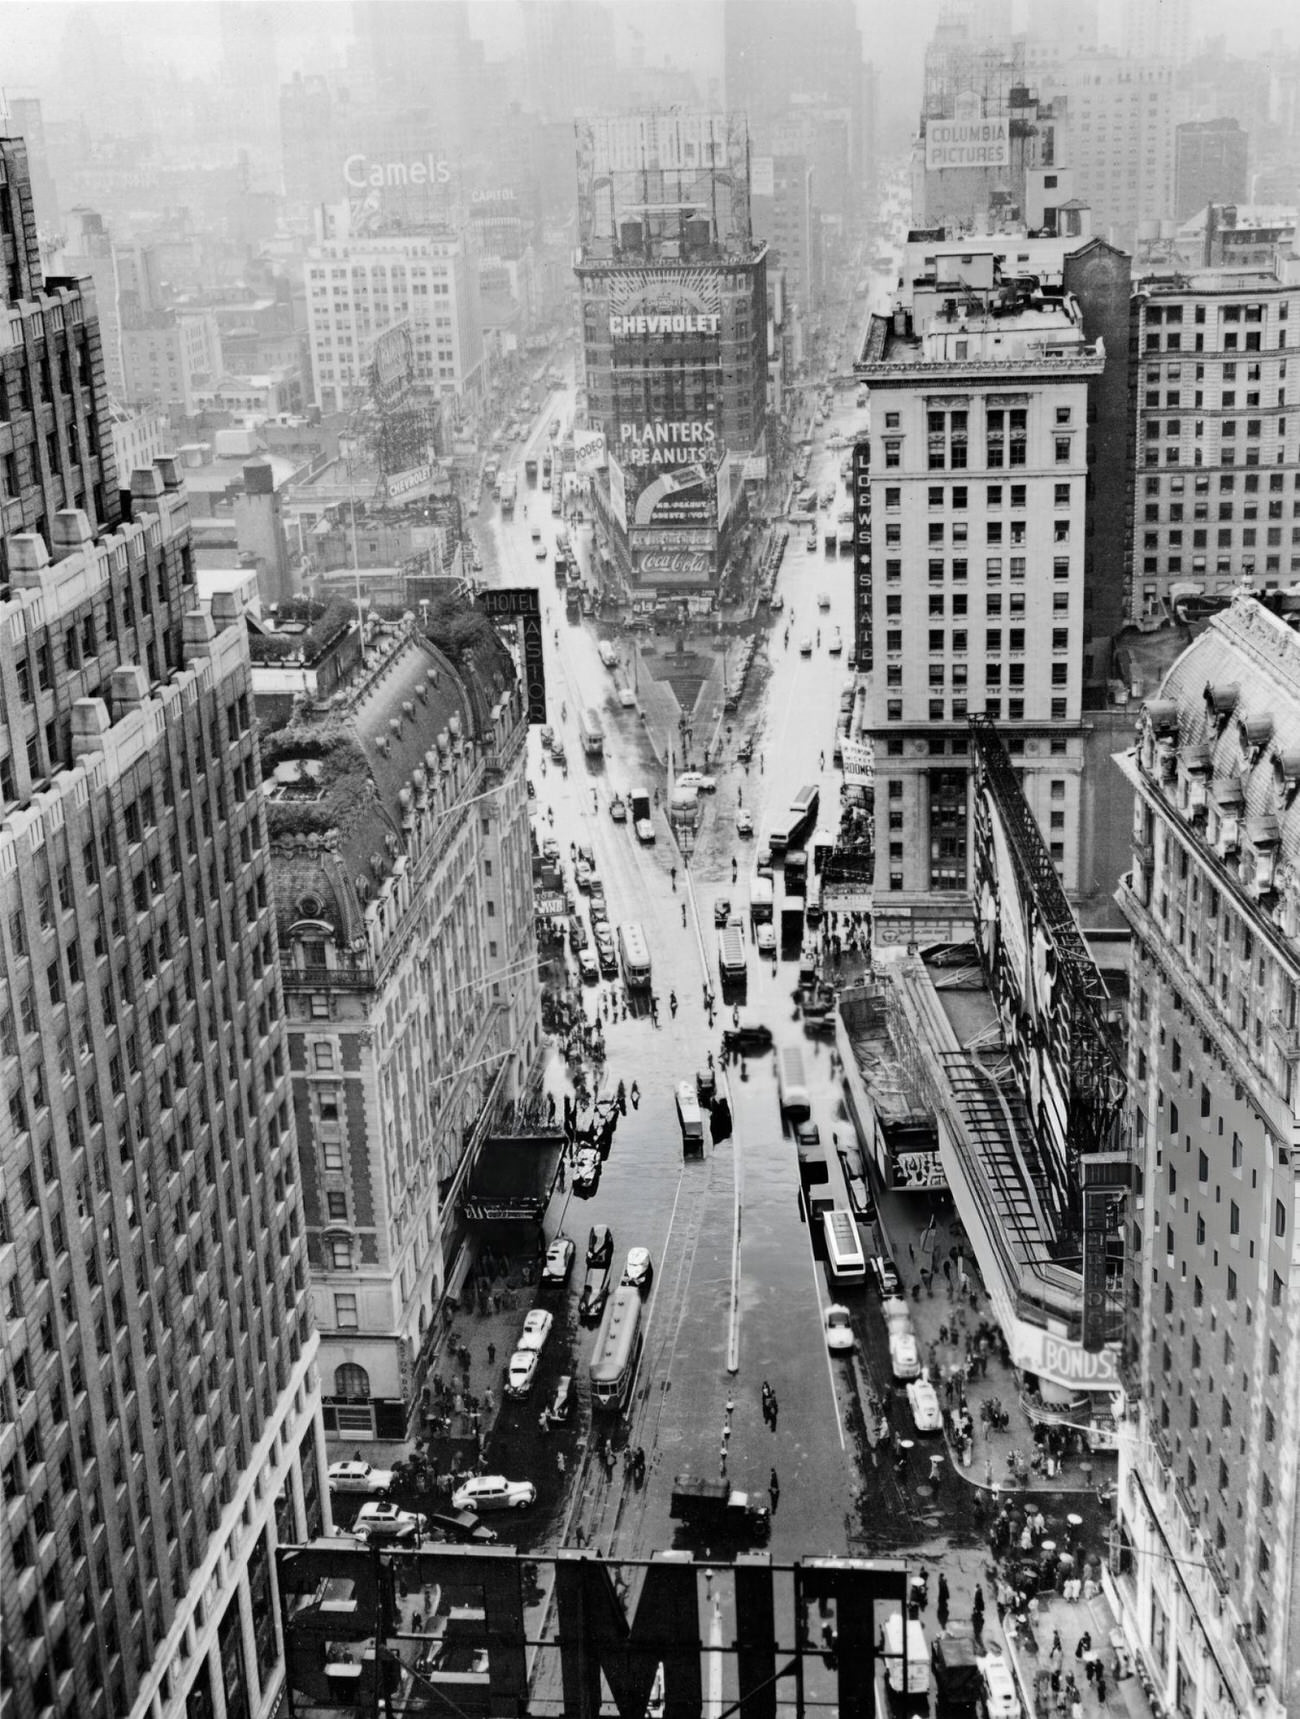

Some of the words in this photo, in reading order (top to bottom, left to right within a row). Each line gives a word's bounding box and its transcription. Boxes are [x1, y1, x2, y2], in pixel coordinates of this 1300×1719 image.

[932, 125, 1006, 142] COLUMBIA
[932, 146, 1004, 163] PICTURES
[343, 152, 450, 187] Camels
[472, 188, 517, 202] CAPITOL
[609, 314, 721, 334] CHEVROLET
[620, 422, 716, 443] PLANTERS
[631, 448, 708, 465] PEANUTS
[390, 469, 430, 497] CHEVROLET
[487, 593, 538, 611] HOTEL
[859, 574, 873, 660] STATE
[525, 619, 545, 720] ASTOR
